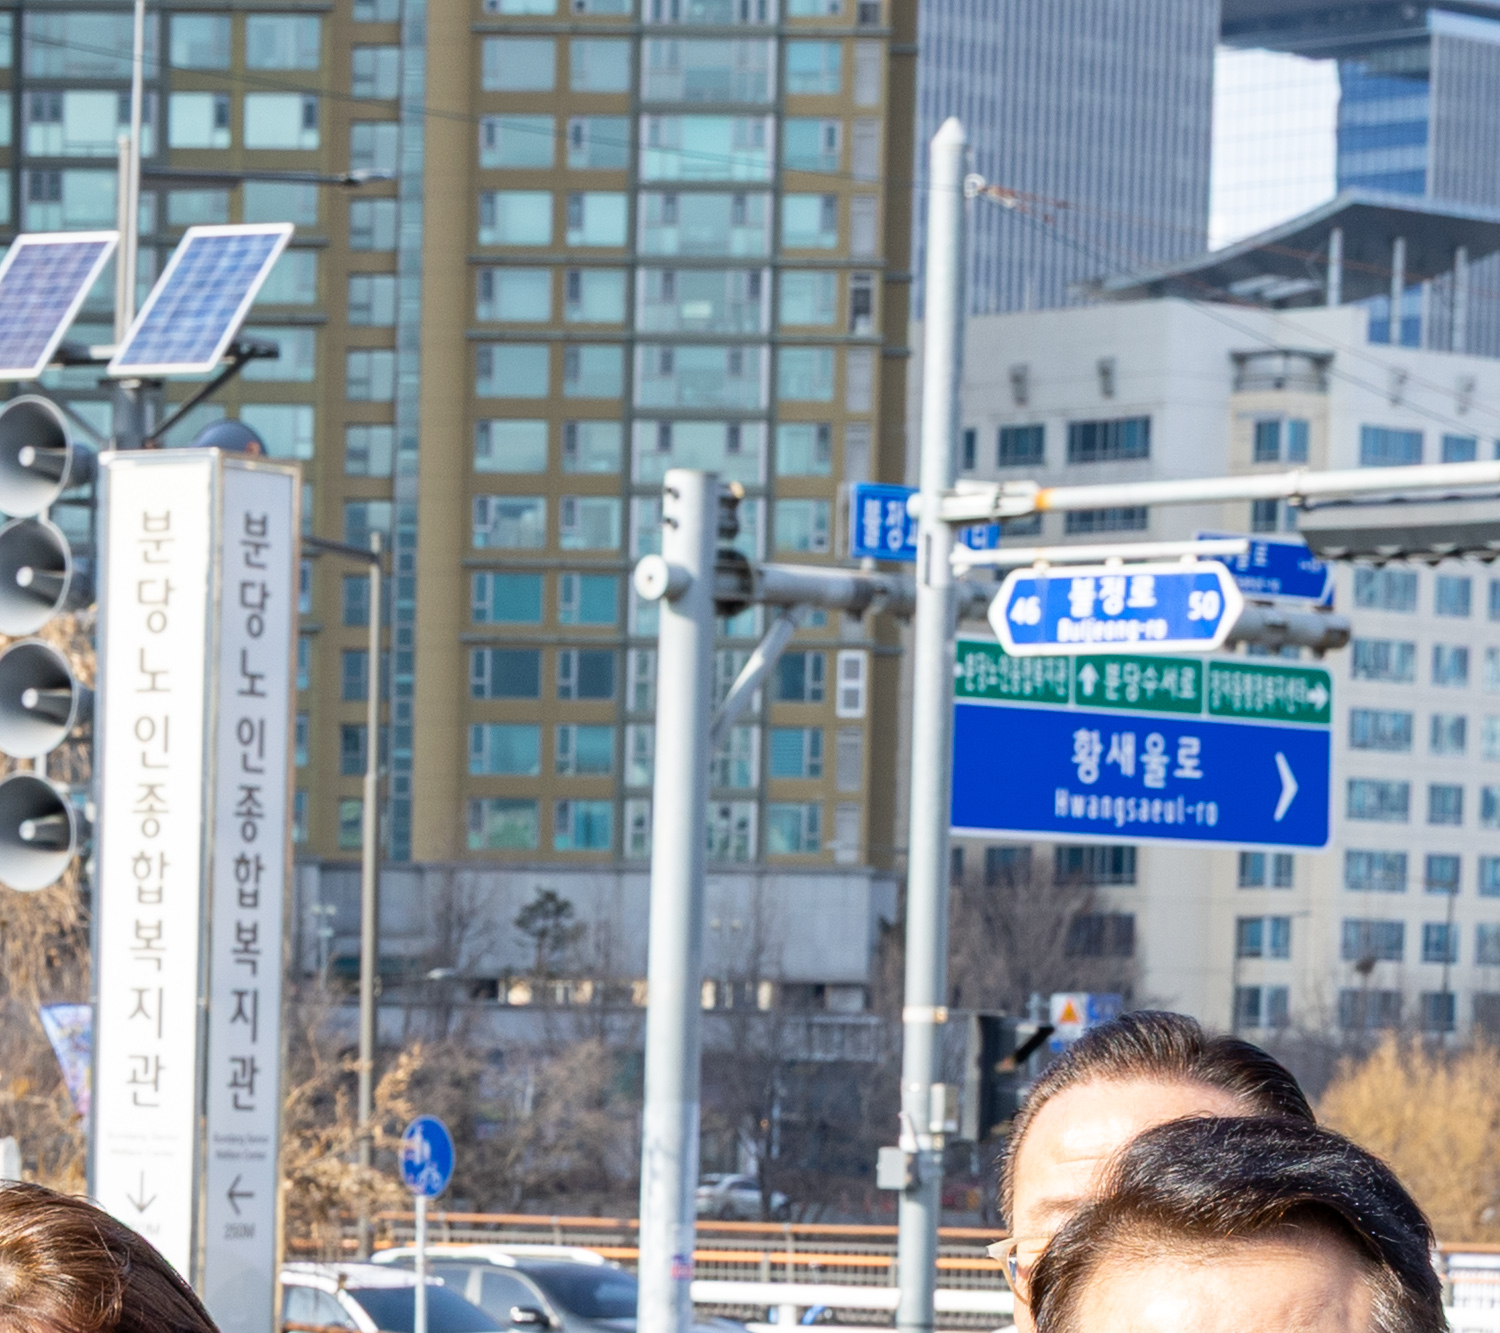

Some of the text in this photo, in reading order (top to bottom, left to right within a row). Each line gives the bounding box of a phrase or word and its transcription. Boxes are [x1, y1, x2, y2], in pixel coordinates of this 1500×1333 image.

[1009, 595, 1041, 625] 46
[1068, 575, 1157, 618] 불정로
[1188, 590, 1220, 620] 50
[1104, 661, 1198, 704] 분당수서로
[1070, 728, 1204, 789] 황새울로
[126, 509, 175, 1108] 분당노인종합복지관
[226, 511, 271, 1112] 분당노인종합복지관
[1054, 787, 1219, 828] Hwangsaeul-ro
